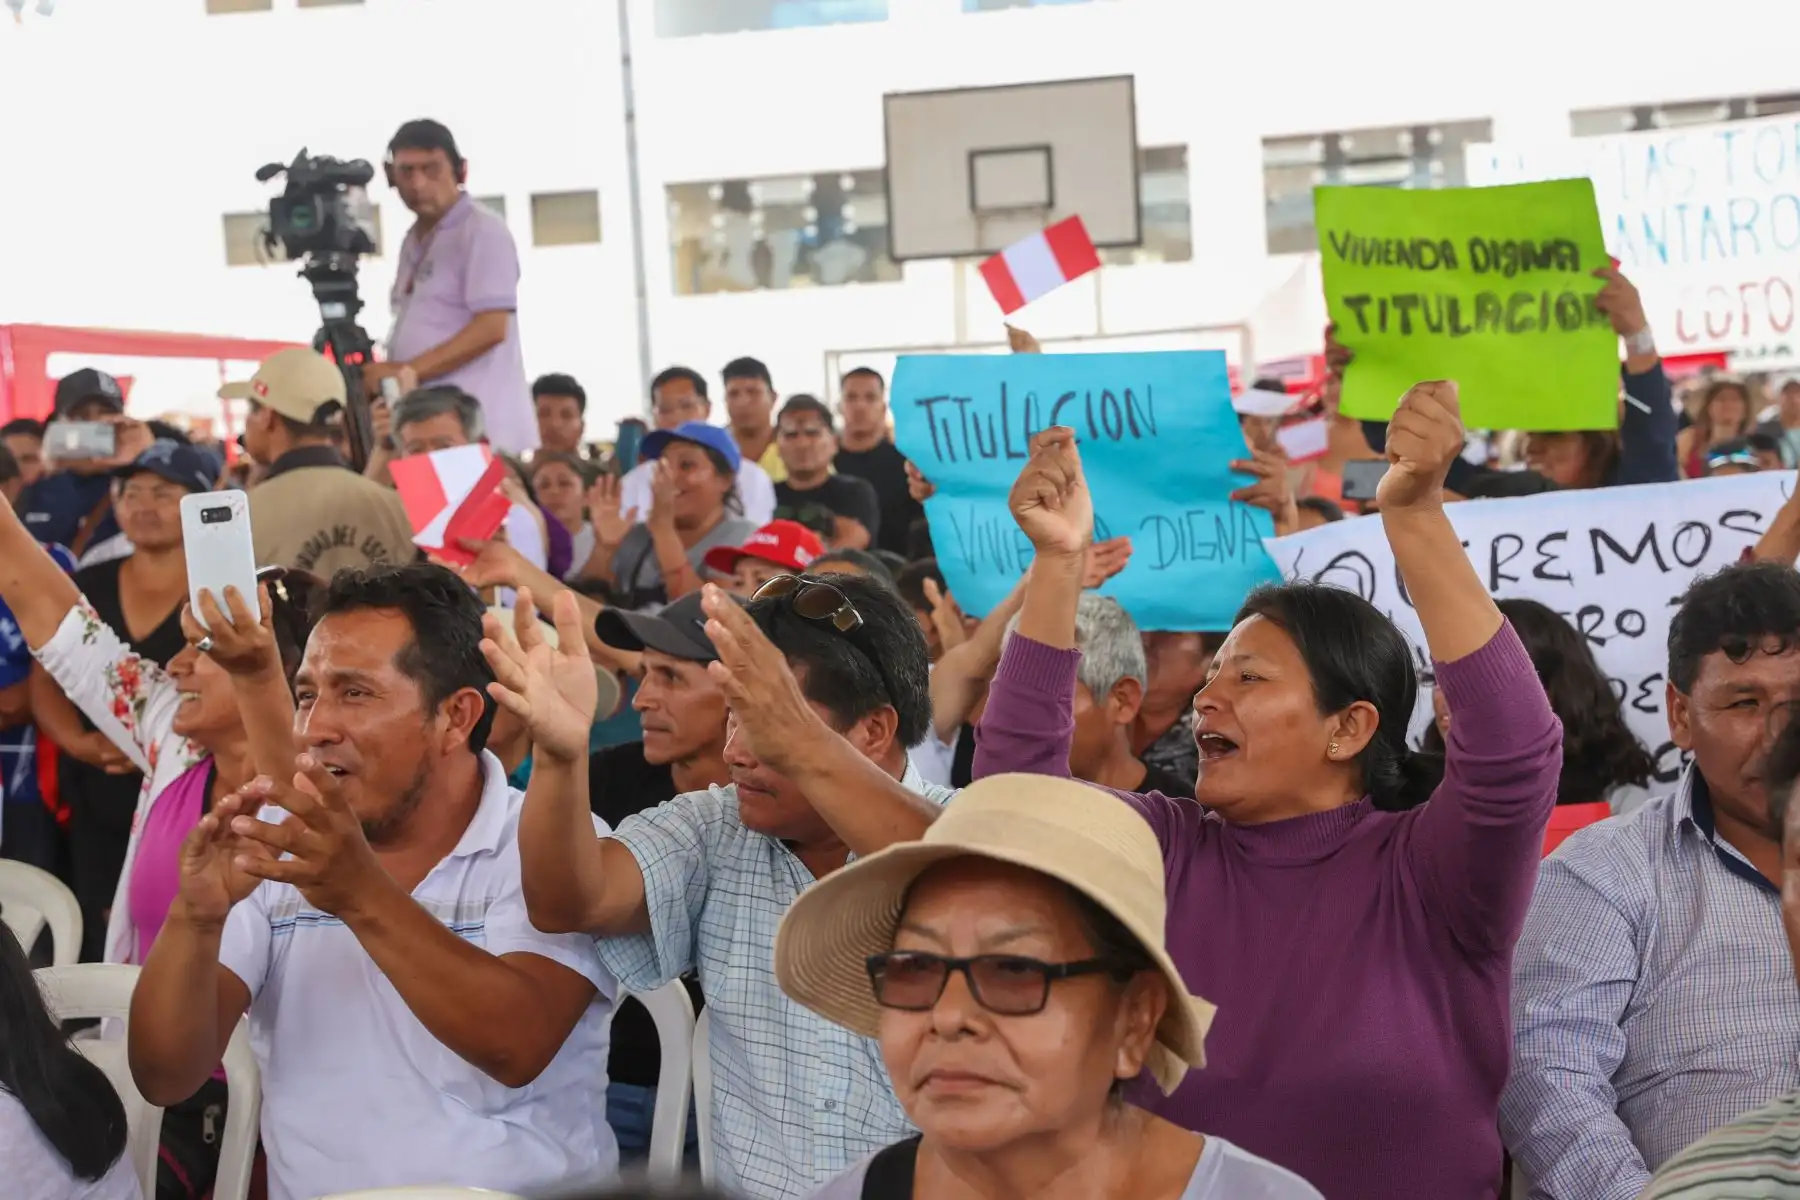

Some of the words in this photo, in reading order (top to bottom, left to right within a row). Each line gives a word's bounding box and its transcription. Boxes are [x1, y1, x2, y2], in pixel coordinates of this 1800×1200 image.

[1713, 122, 1800, 186] TO
[1328, 229, 1459, 271] VIVIENDA
[1613, 194, 1800, 266] ANTARO
[915, 381, 1157, 463] TITULACION
[1140, 506, 1266, 571] DIGNA
